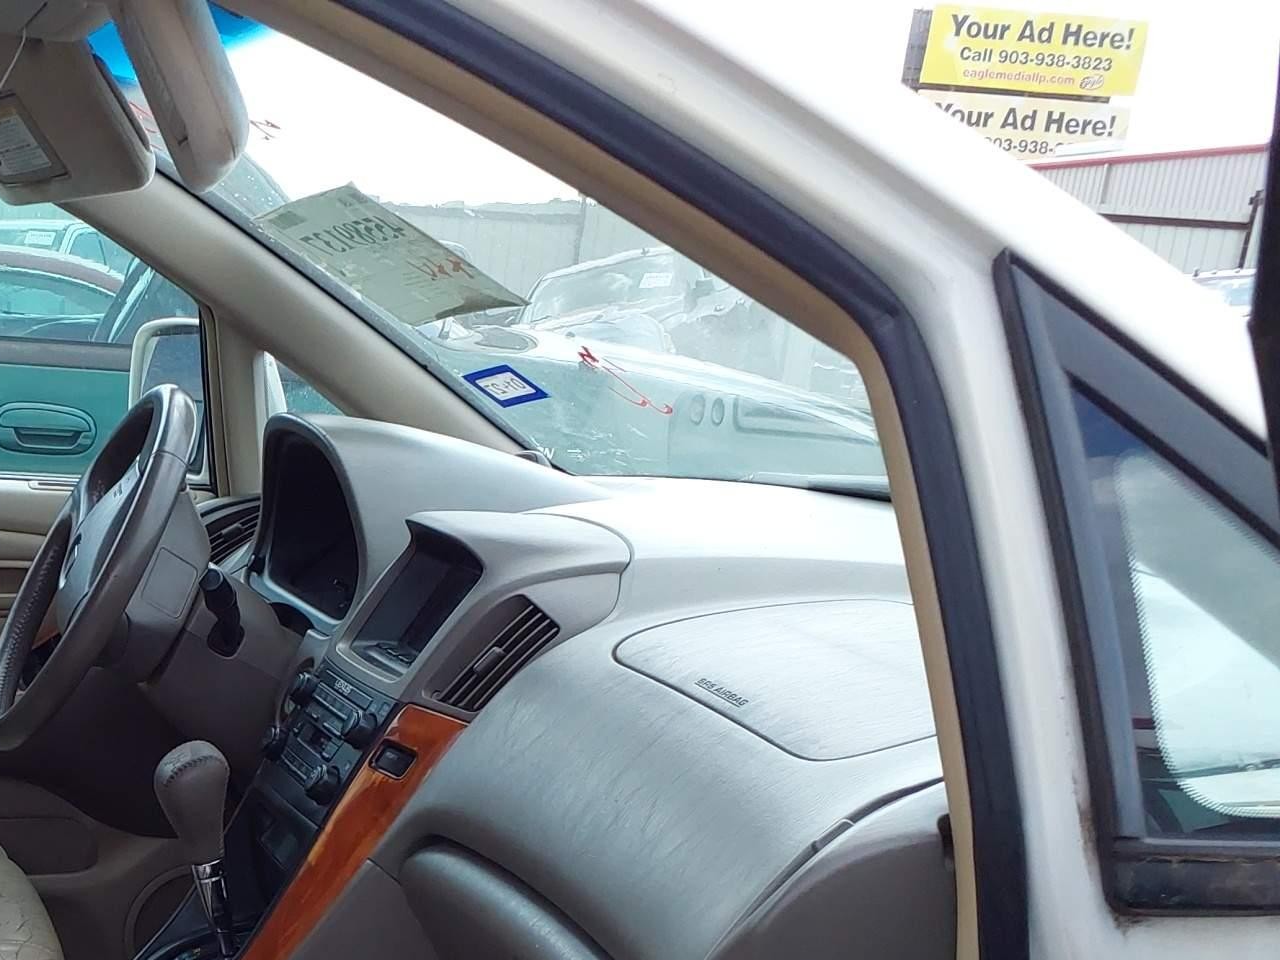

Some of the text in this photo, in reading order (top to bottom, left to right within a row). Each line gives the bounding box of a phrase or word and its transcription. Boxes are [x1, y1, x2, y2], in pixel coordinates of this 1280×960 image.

[951, 14, 1135, 50] Your Ad Here!
[959, 46, 1113, 72] Call 903-938-3823
[963, 69, 1075, 86] eaglemediallp.com
[1000, 107, 1038, 132] Ad
[1044, 110, 1116, 137] Here!
[713, 686, 749, 707] AIRBAG
